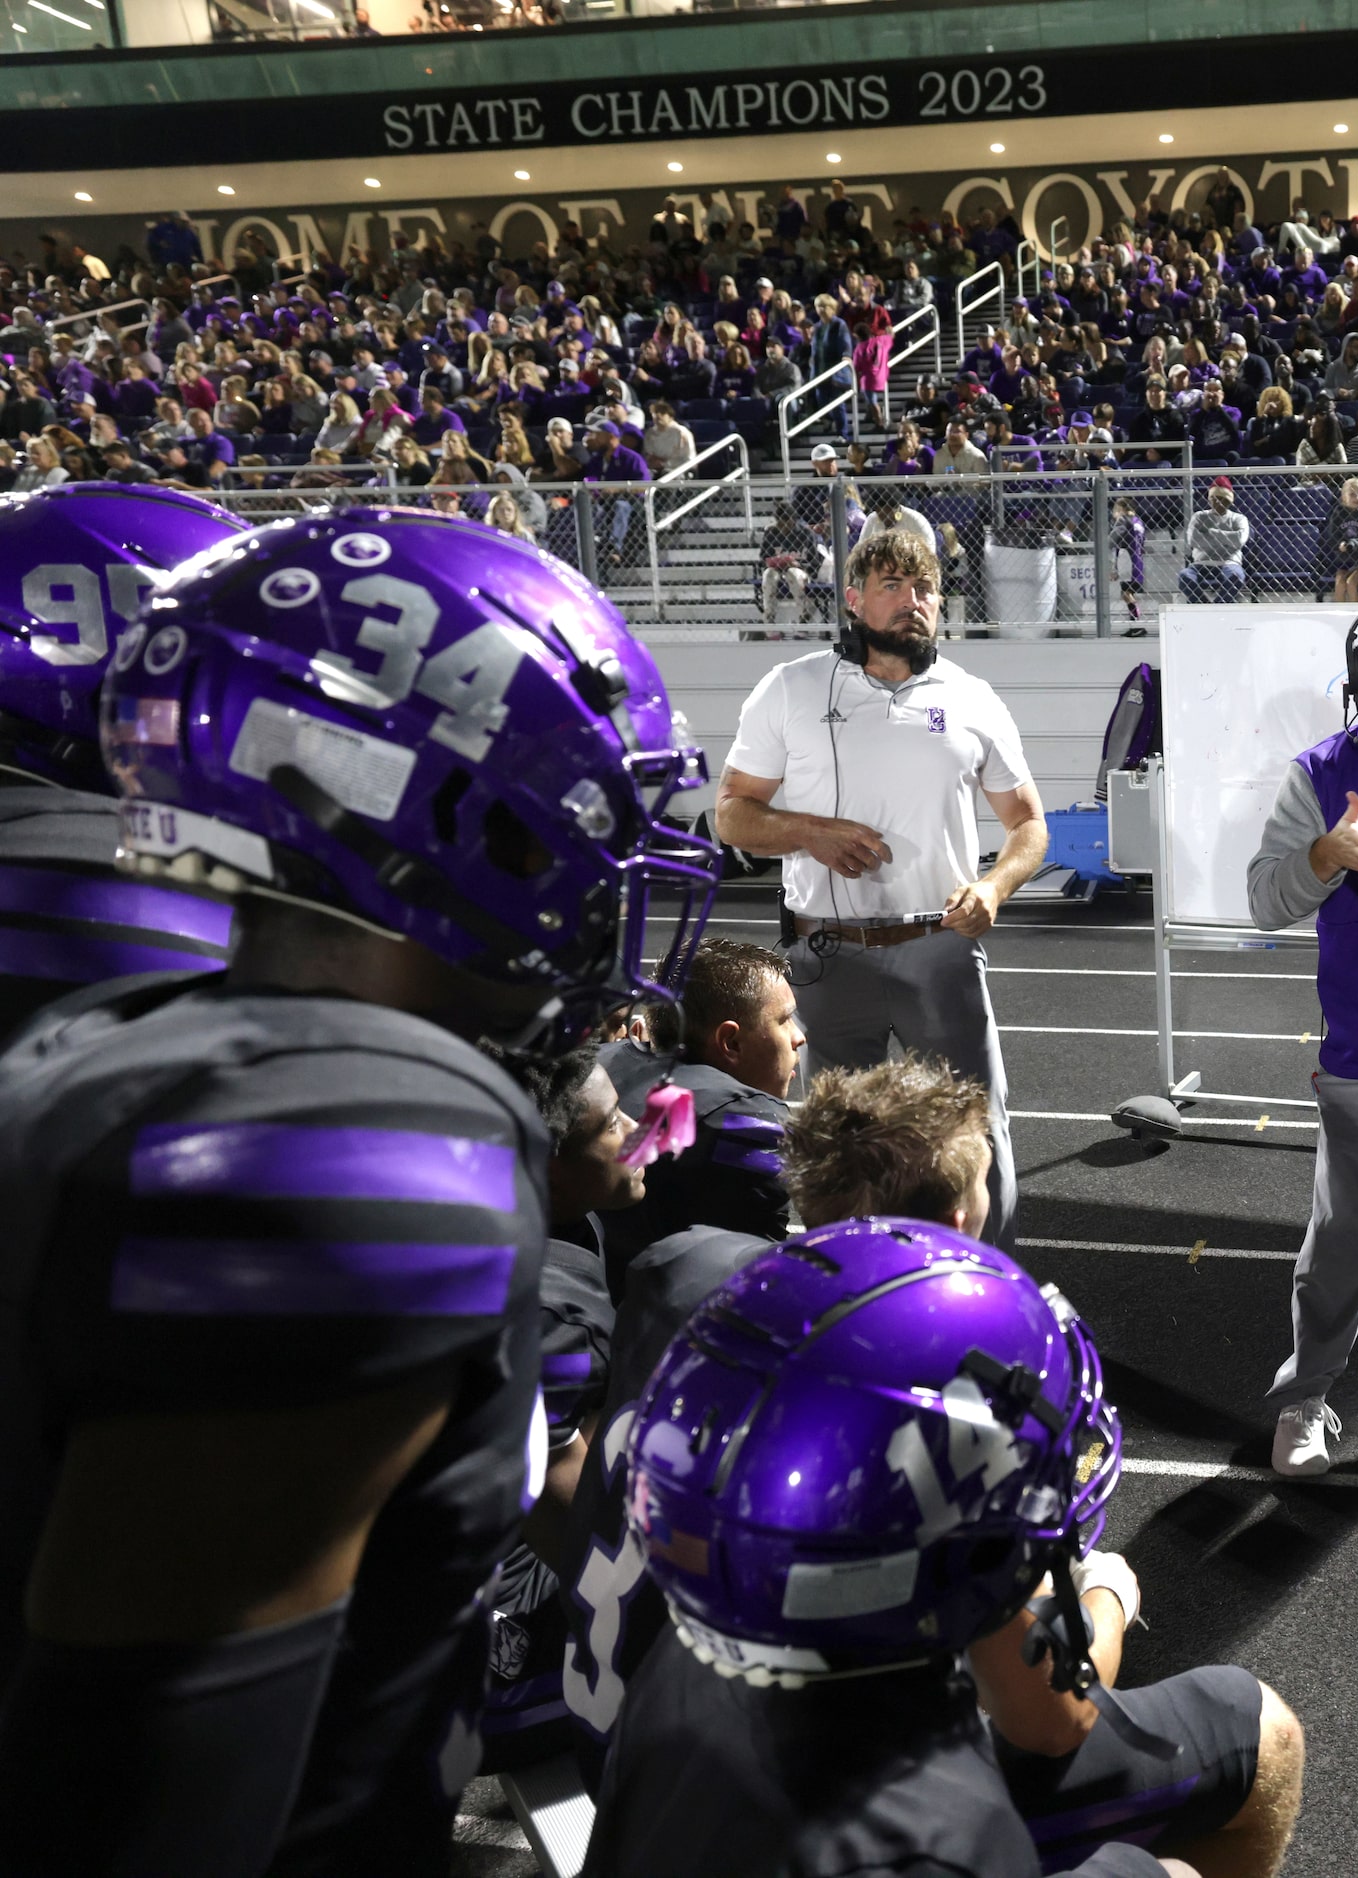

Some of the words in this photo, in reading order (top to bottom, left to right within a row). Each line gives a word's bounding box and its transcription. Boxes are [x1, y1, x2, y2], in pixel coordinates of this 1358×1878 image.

[383, 97, 545, 149] STATE
[570, 74, 890, 138] CHAMPIONS
[918, 64, 1047, 118] 2023
[309, 572, 542, 764] 34
[885, 1374, 1031, 1550] 14
